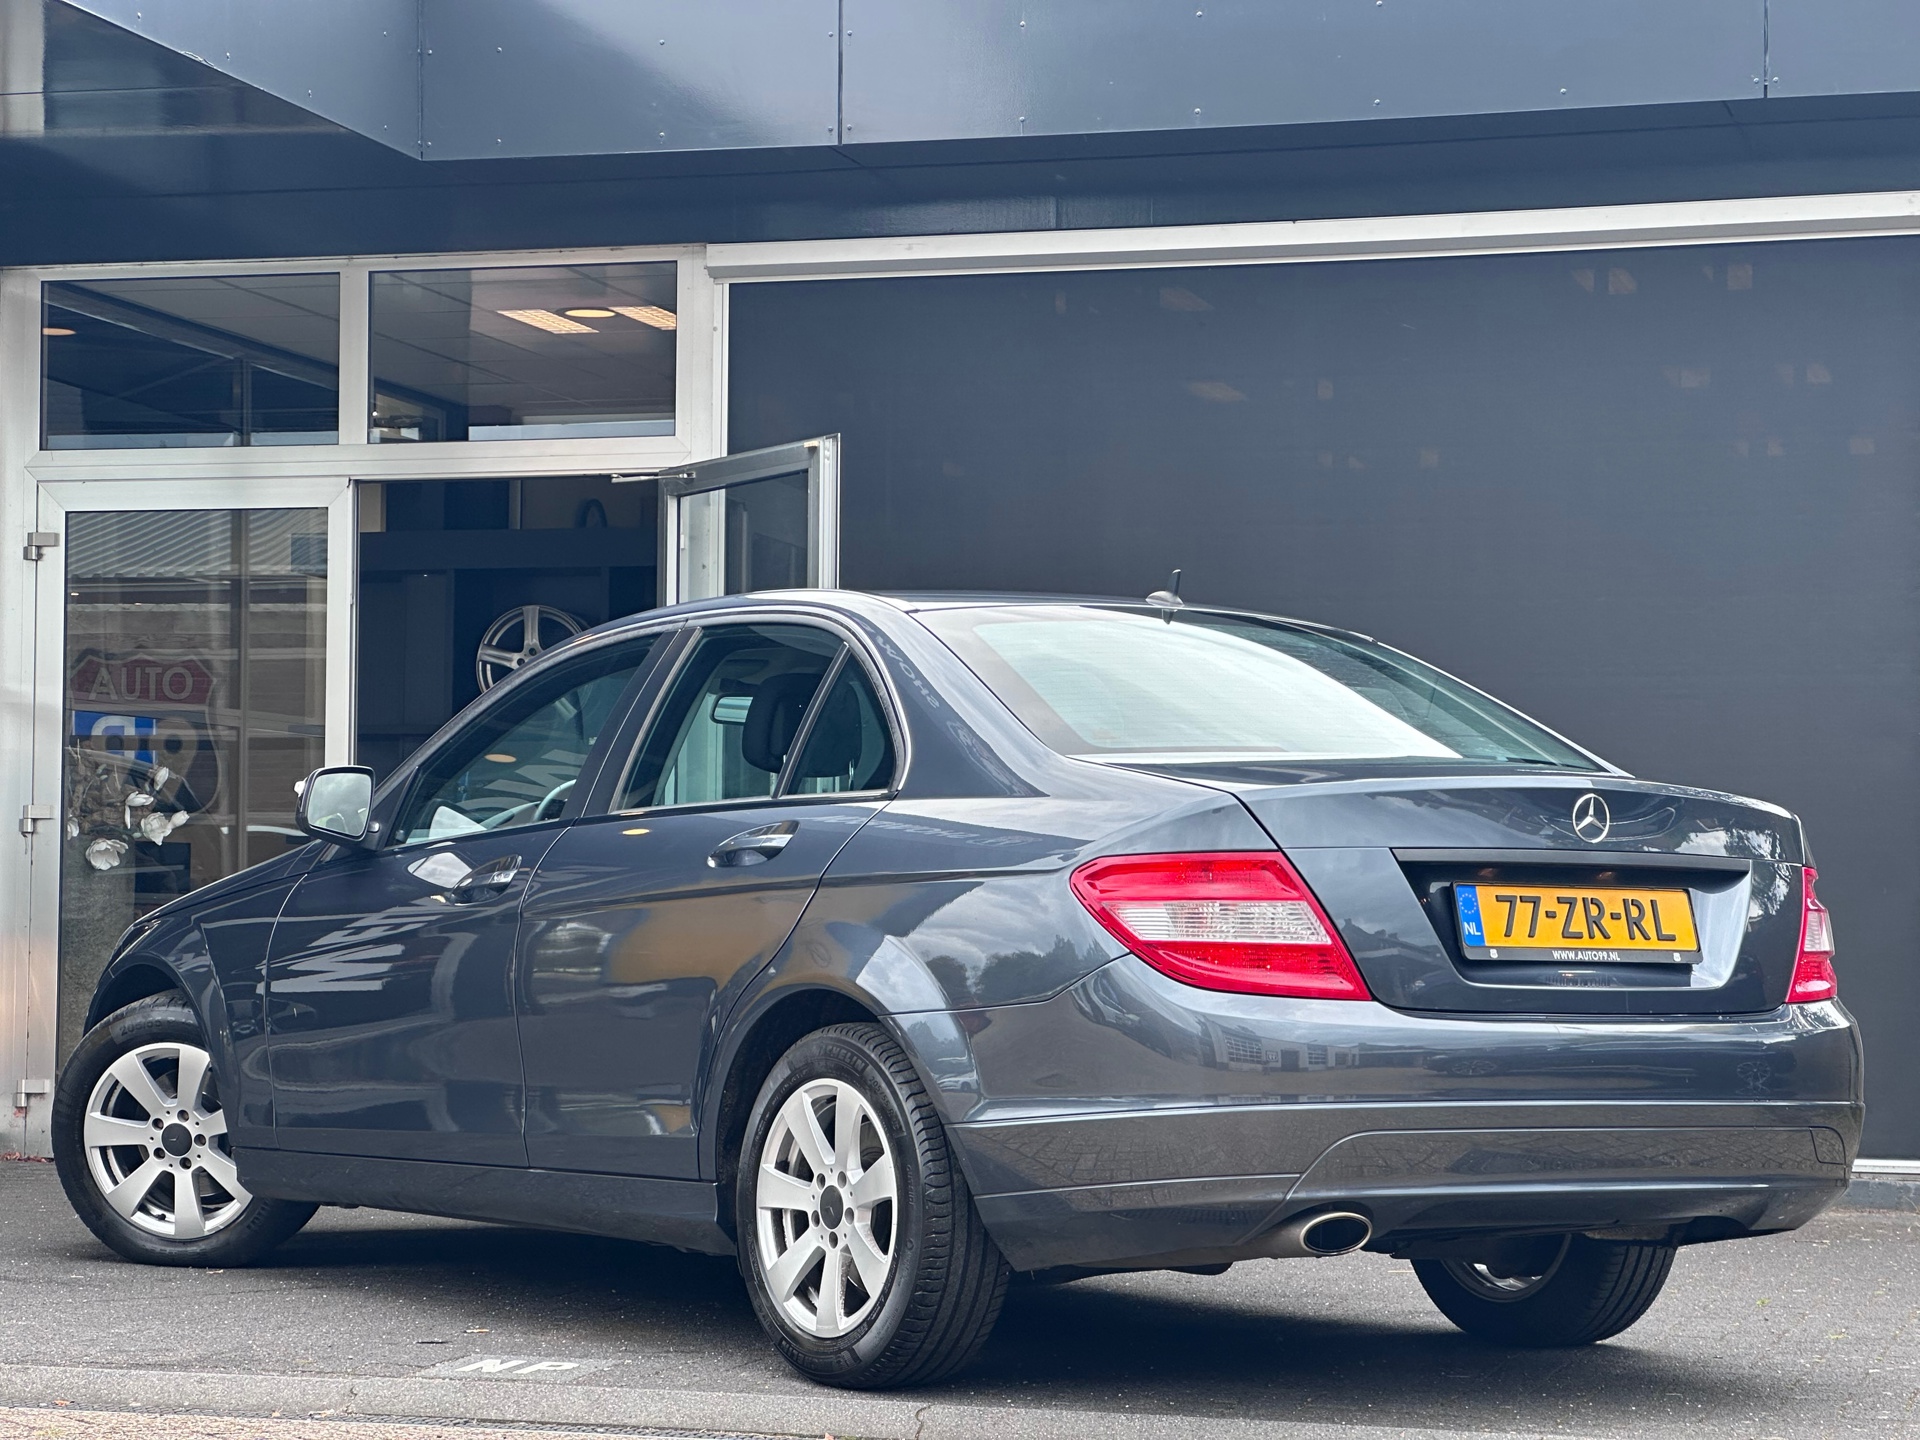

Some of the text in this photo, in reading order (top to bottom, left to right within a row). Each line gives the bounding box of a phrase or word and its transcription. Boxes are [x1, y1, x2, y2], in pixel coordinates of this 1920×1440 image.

[88, 666, 194, 701] AUTO
[1495, 894, 1677, 942] 77-ZR-RL
[1464, 921, 1481, 936] NL
[1552, 950, 1621, 961] WWW.AUTO99.NL
[455, 1359, 580, 1374] NP
